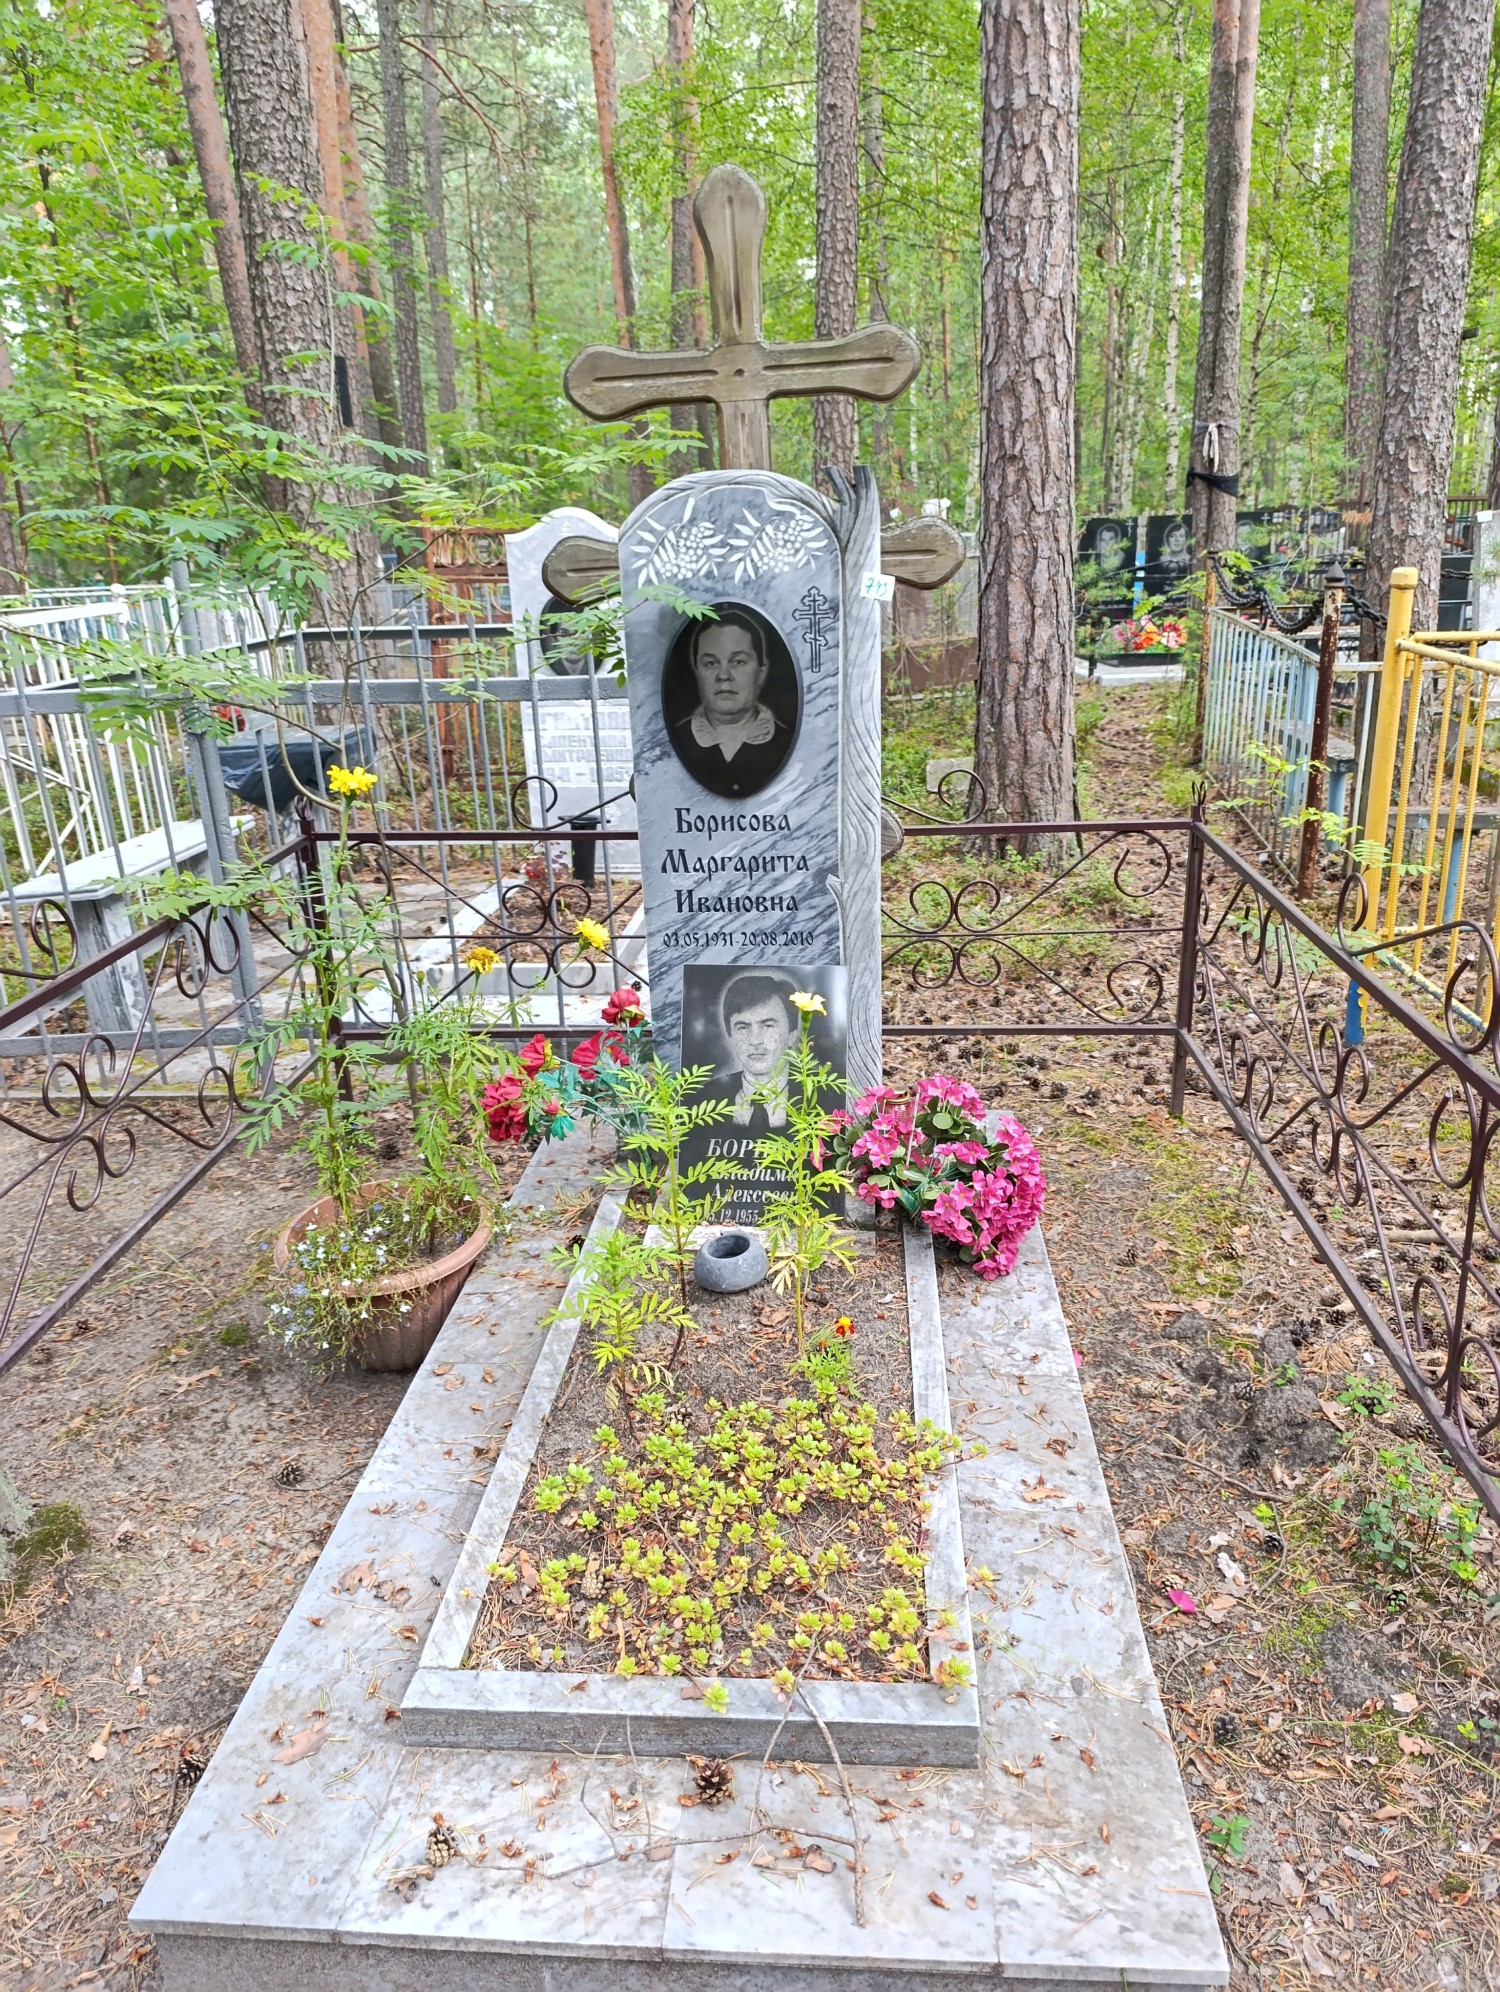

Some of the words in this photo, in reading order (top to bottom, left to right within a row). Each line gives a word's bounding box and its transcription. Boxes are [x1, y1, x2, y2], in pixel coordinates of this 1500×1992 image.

[674, 807, 792, 841] Борисова
[660, 848, 810, 882] Маргарита
[674, 889, 800, 914] Ивановна
[663, 931, 815, 949] 03.05.1931-20.08.2010
